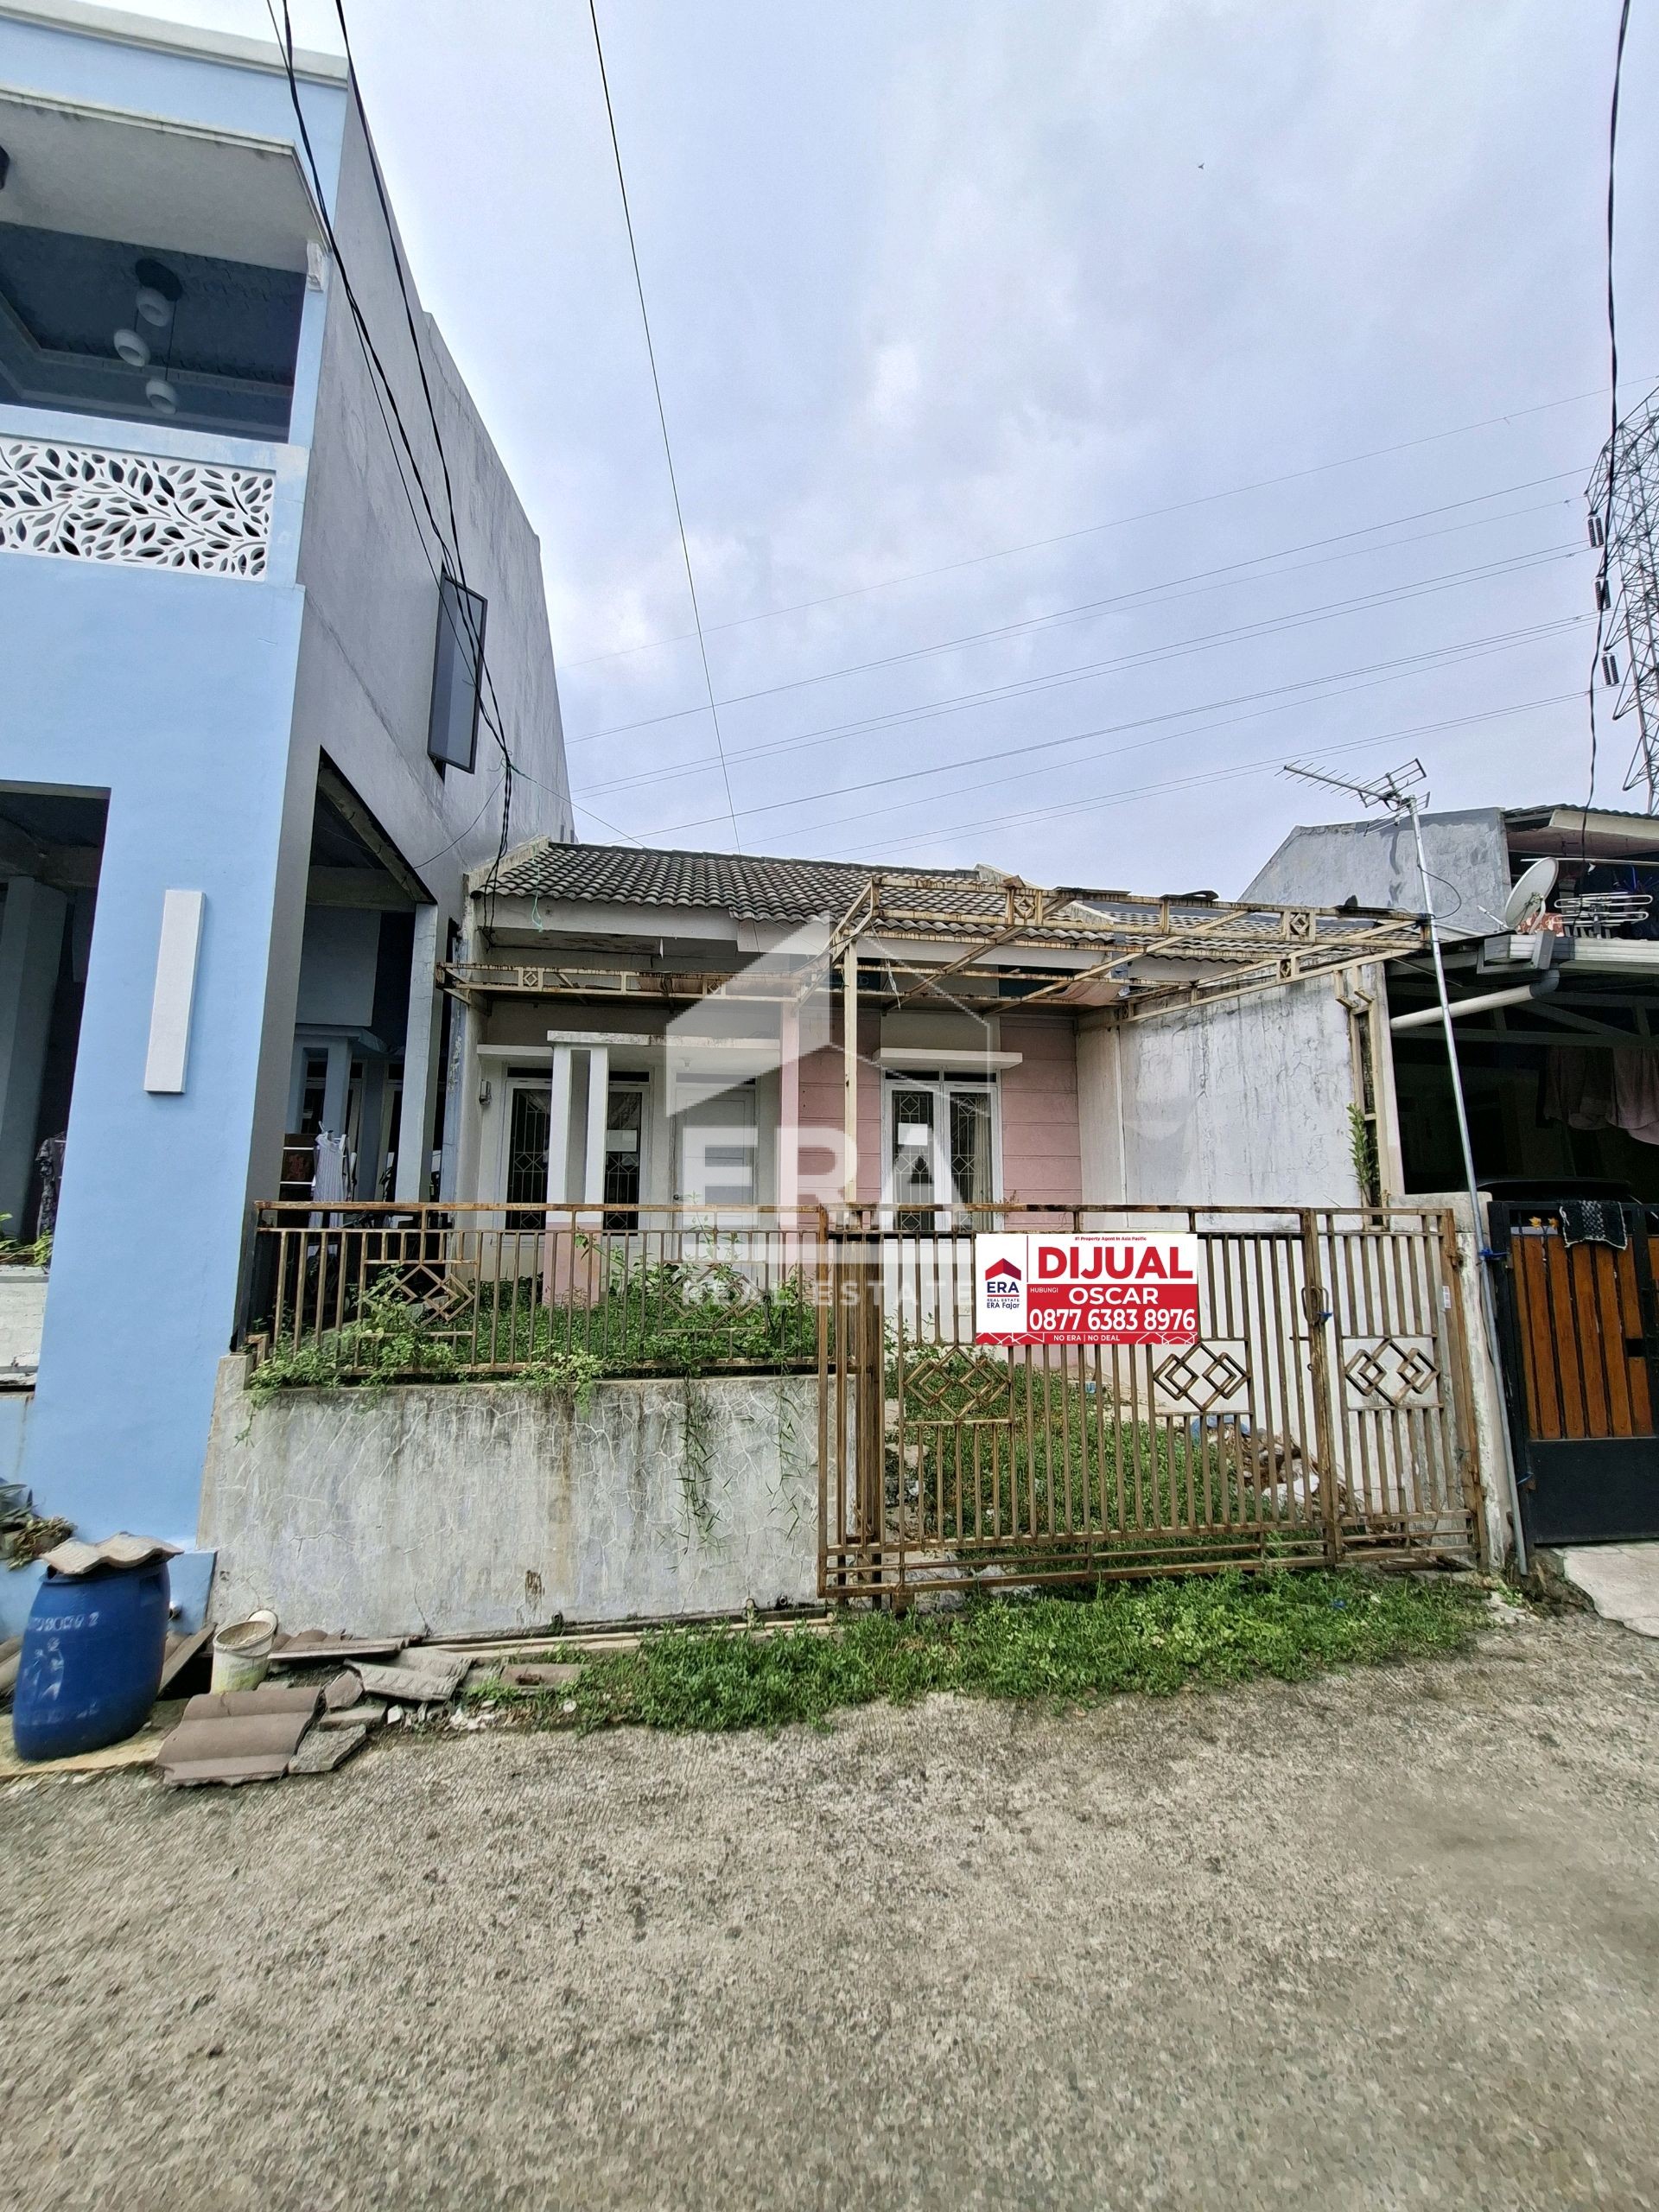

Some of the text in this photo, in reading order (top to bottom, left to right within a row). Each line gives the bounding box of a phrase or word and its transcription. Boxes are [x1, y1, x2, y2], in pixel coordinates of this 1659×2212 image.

[1038, 1246, 1193, 1279] DIJUAL
[987, 1281, 1020, 1294] ERA
[1068, 1287, 1159, 1305] OSCAR
[1029, 1308, 1196, 1331] 0877 6383 8976
